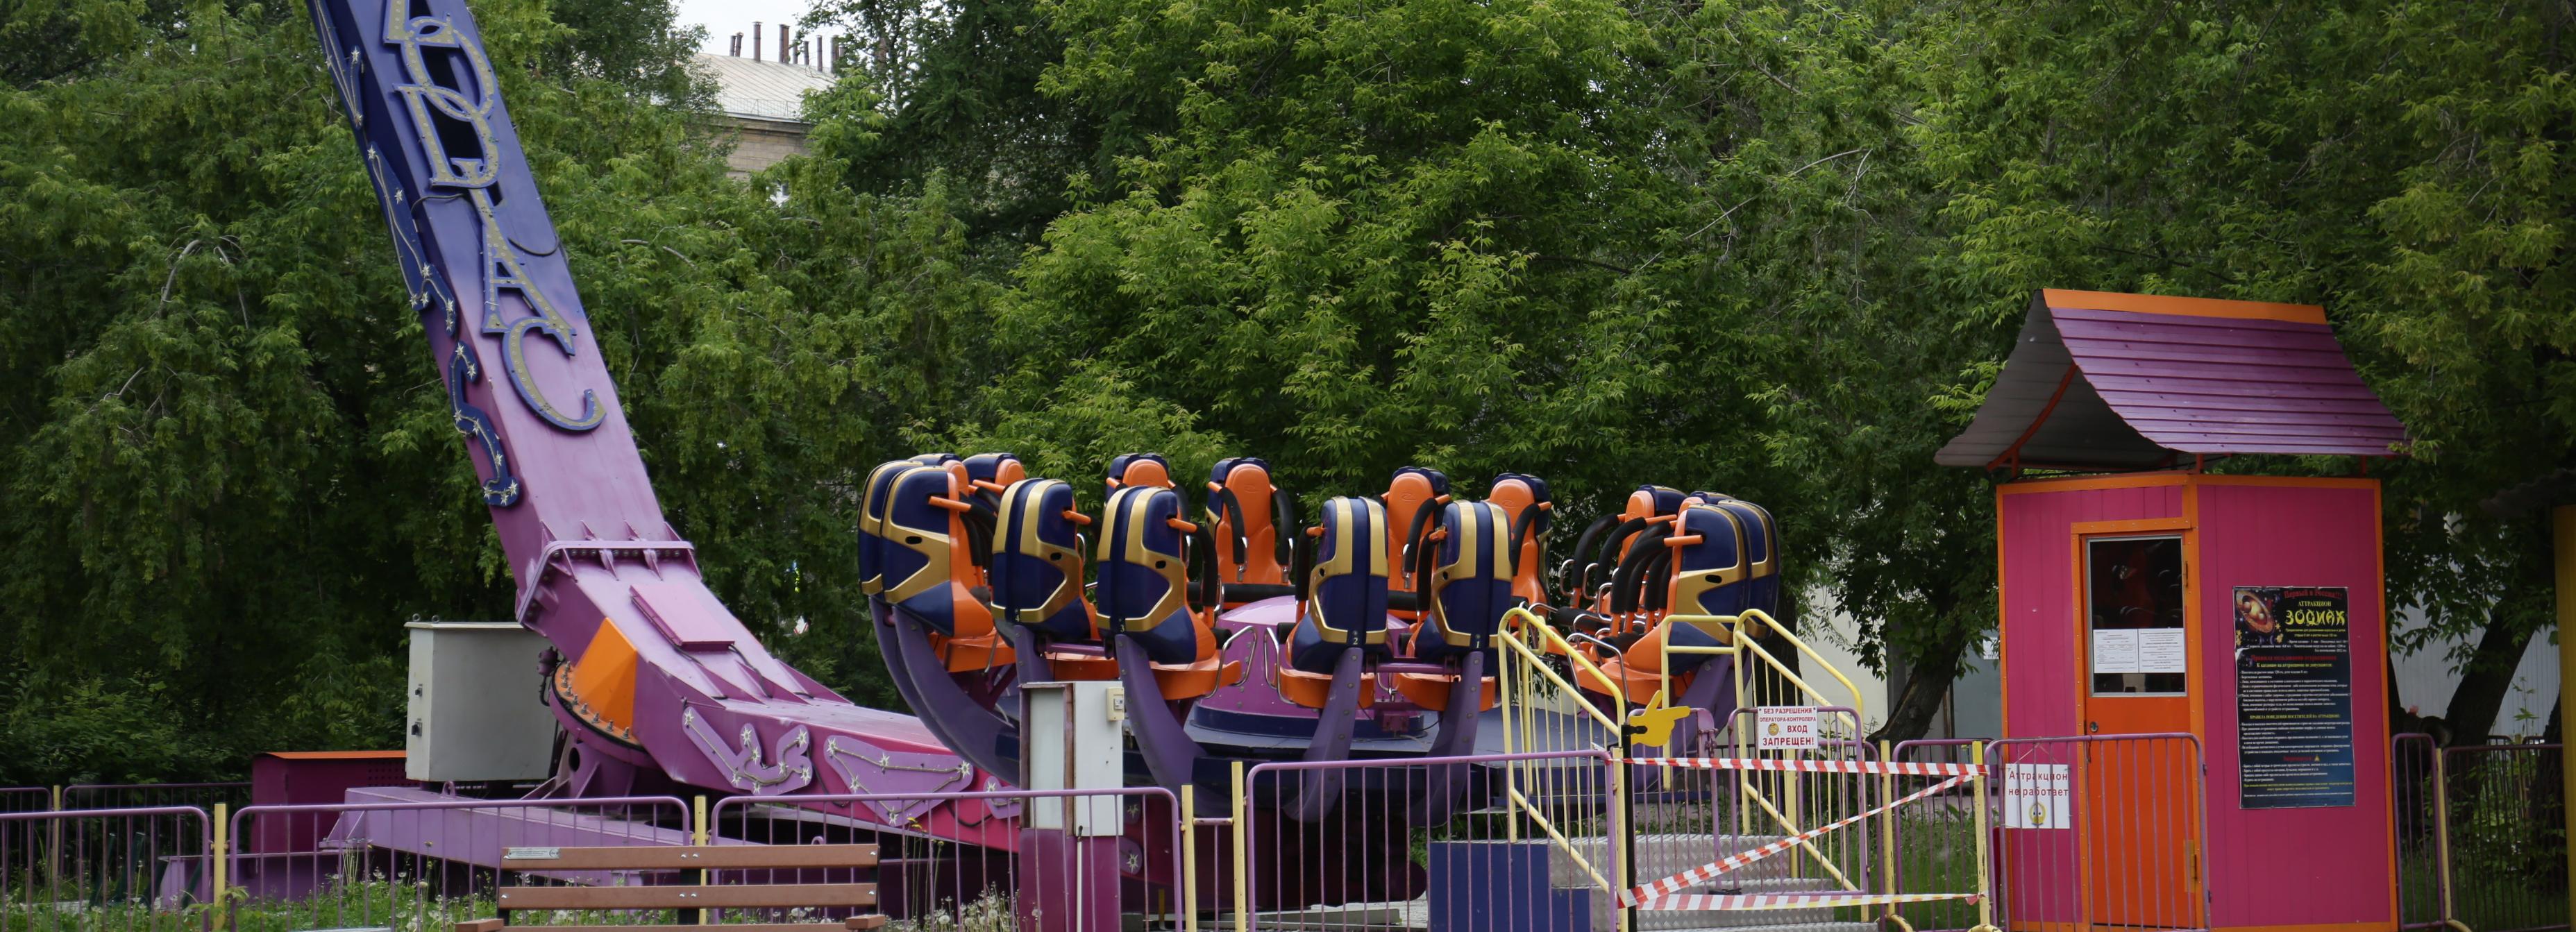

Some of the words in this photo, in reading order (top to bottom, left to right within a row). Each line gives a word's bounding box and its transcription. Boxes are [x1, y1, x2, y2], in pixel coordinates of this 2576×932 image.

[1353, 637, 1358, 645] 2
[1476, 641, 1480, 649] 1
[1787, 725, 1808, 734] ВХОД
[1763, 738, 1814, 747] ЗАПРЕЩЕН!
[2023, 786, 2068, 798] работает
